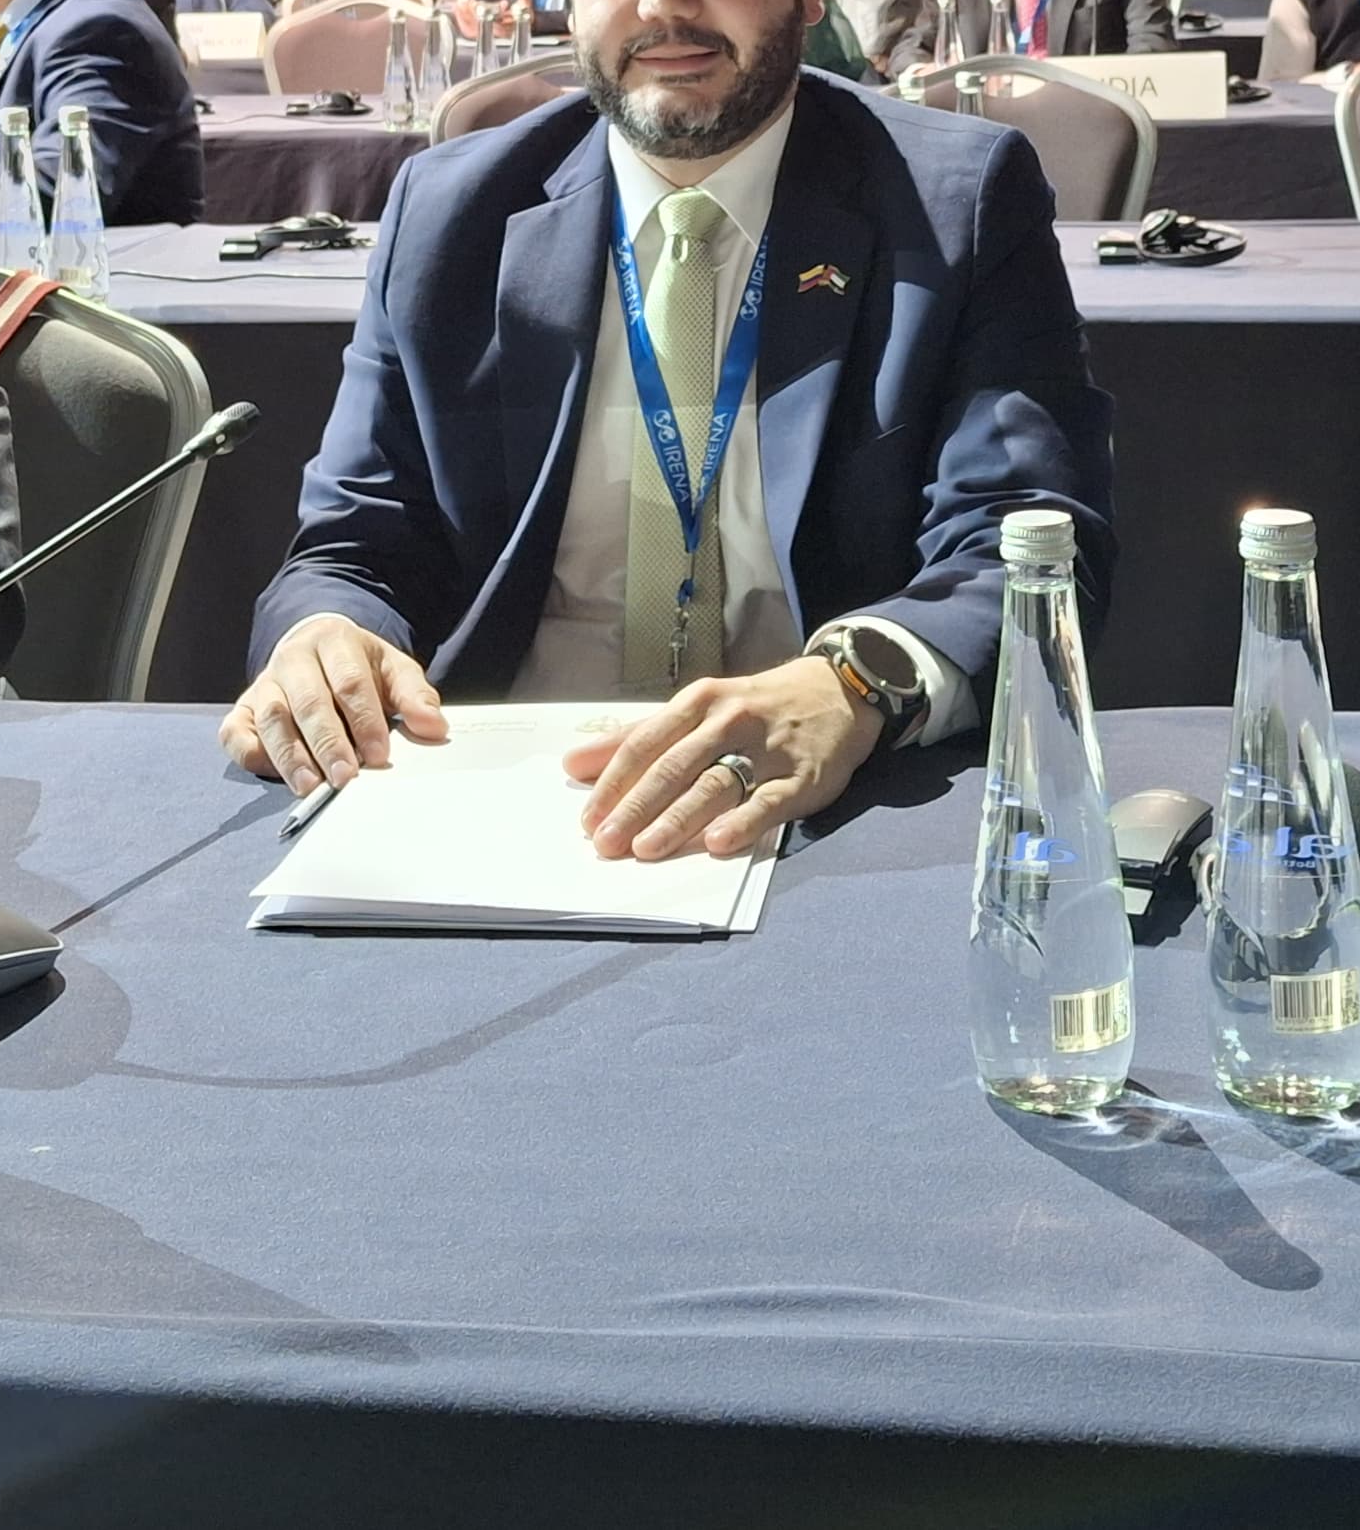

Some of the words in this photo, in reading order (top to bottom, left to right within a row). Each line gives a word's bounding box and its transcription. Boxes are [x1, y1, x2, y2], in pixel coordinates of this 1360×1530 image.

[621, 269, 642, 326] IRENA
[704, 412, 728, 470] IRENA
[663, 445, 690, 503] IRENA
